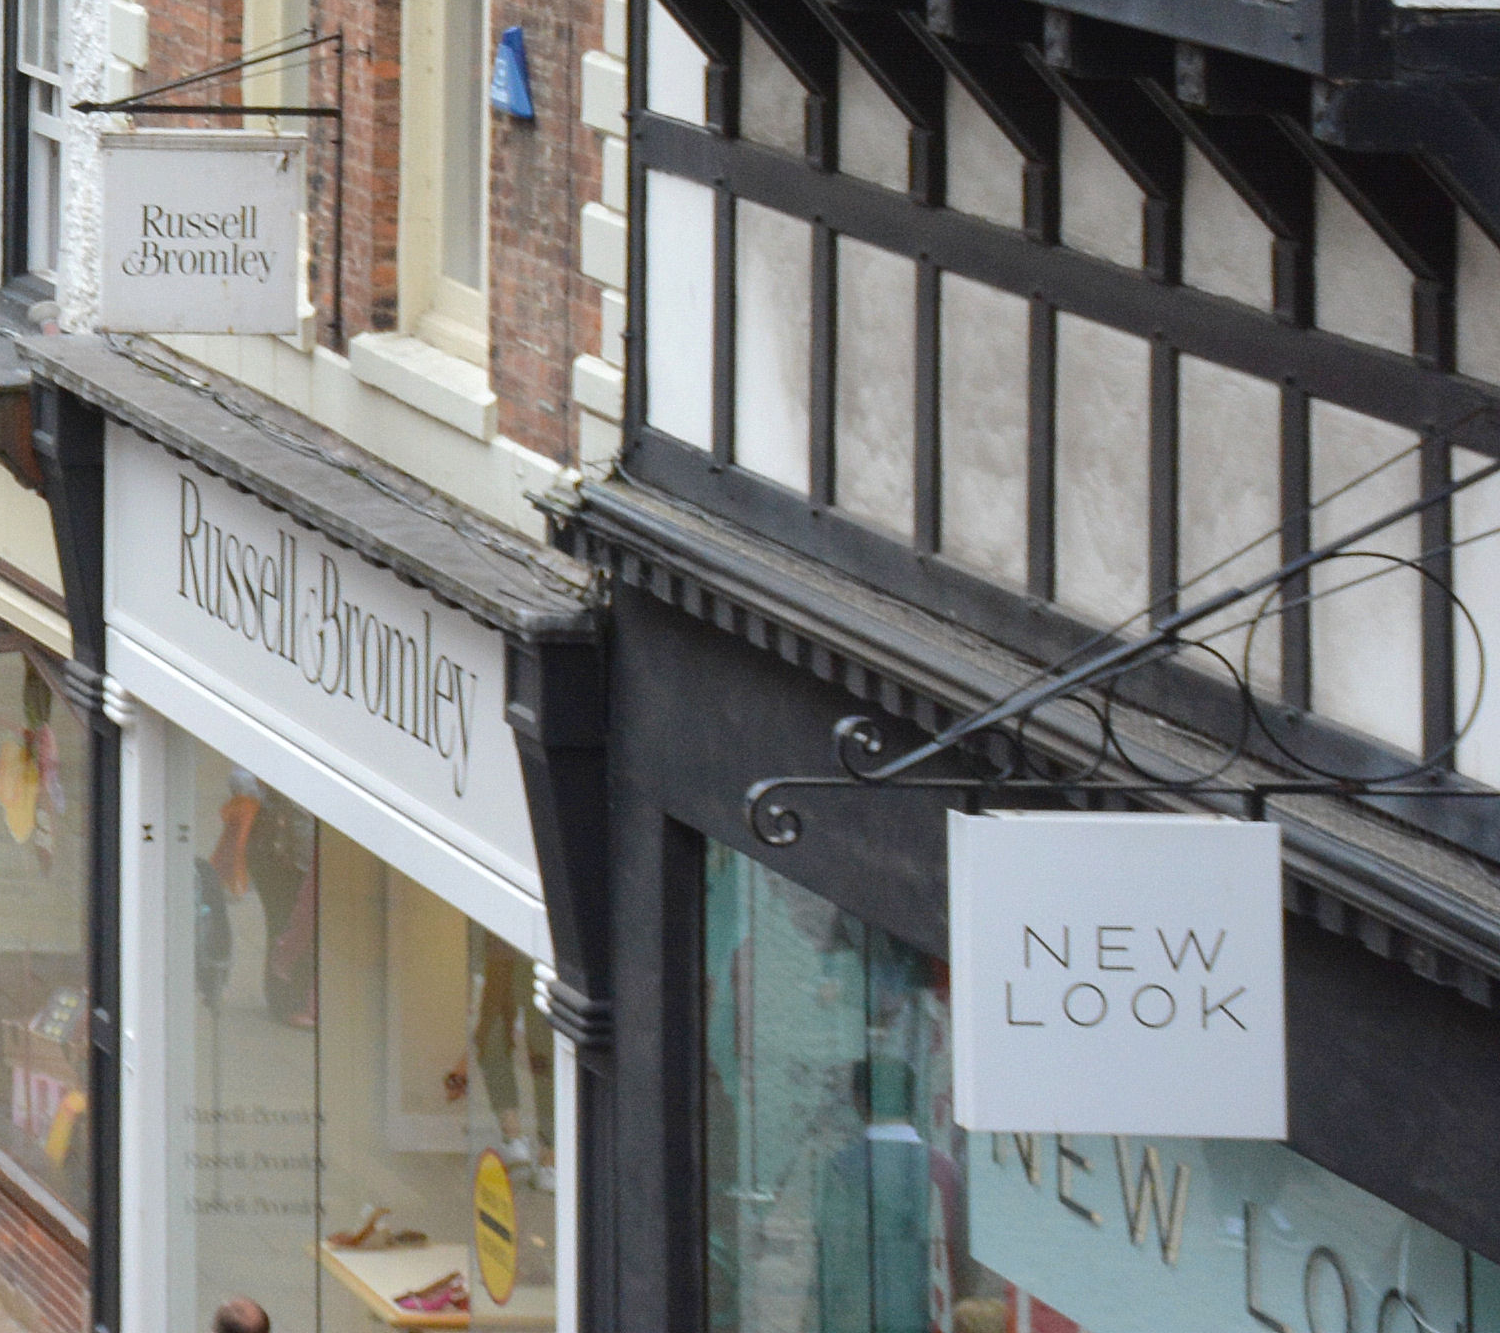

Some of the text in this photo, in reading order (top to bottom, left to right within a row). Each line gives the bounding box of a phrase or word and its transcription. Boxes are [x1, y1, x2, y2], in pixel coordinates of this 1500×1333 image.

[142, 204, 258, 240] Russell
[177, 471, 299, 669] Russell
[1022, 924, 1228, 973] NEW
[1007, 981, 1249, 1032] LOOK
